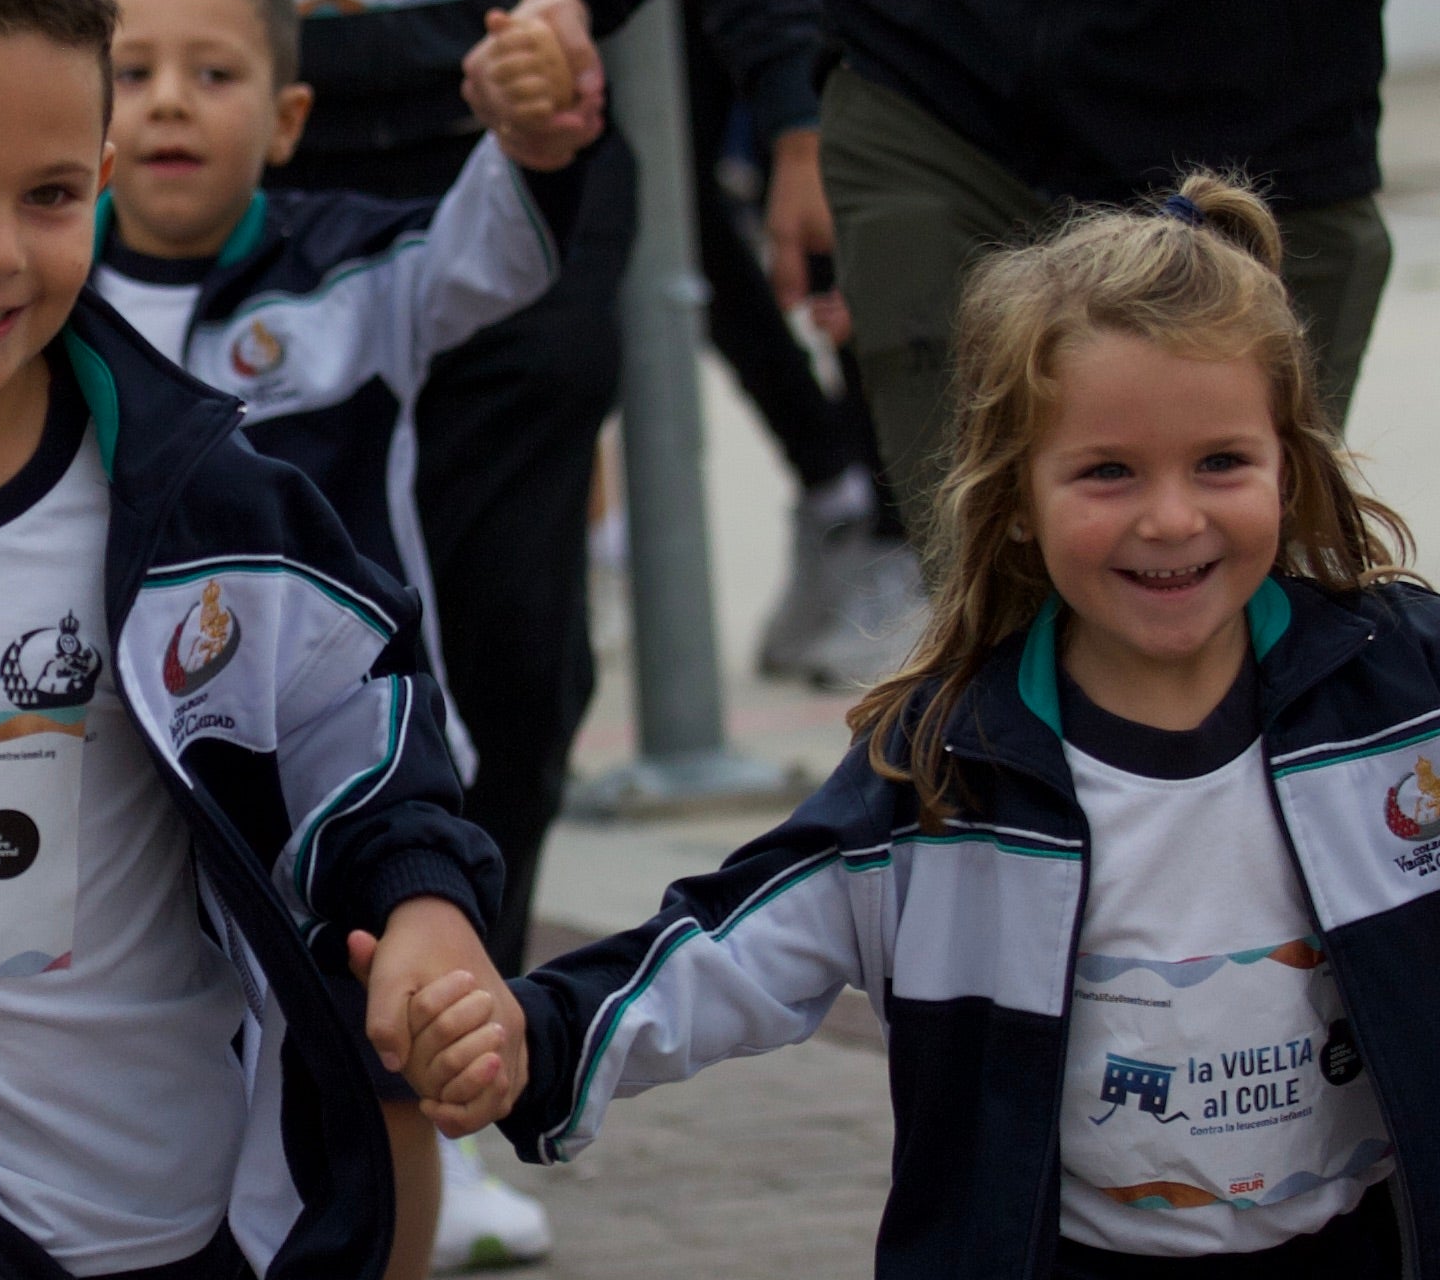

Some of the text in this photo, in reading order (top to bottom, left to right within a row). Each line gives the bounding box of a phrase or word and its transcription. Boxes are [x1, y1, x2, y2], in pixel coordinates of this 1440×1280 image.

[1188, 1037, 1313, 1084] la VUELTA
[1203, 1078, 1300, 1119] al COLE
[1190, 1124, 1223, 1136] Contra
[1225, 1123, 1235, 1133] la
[1236, 1117, 1278, 1131] leucemia
[1229, 1179, 1264, 1194] SEUR
